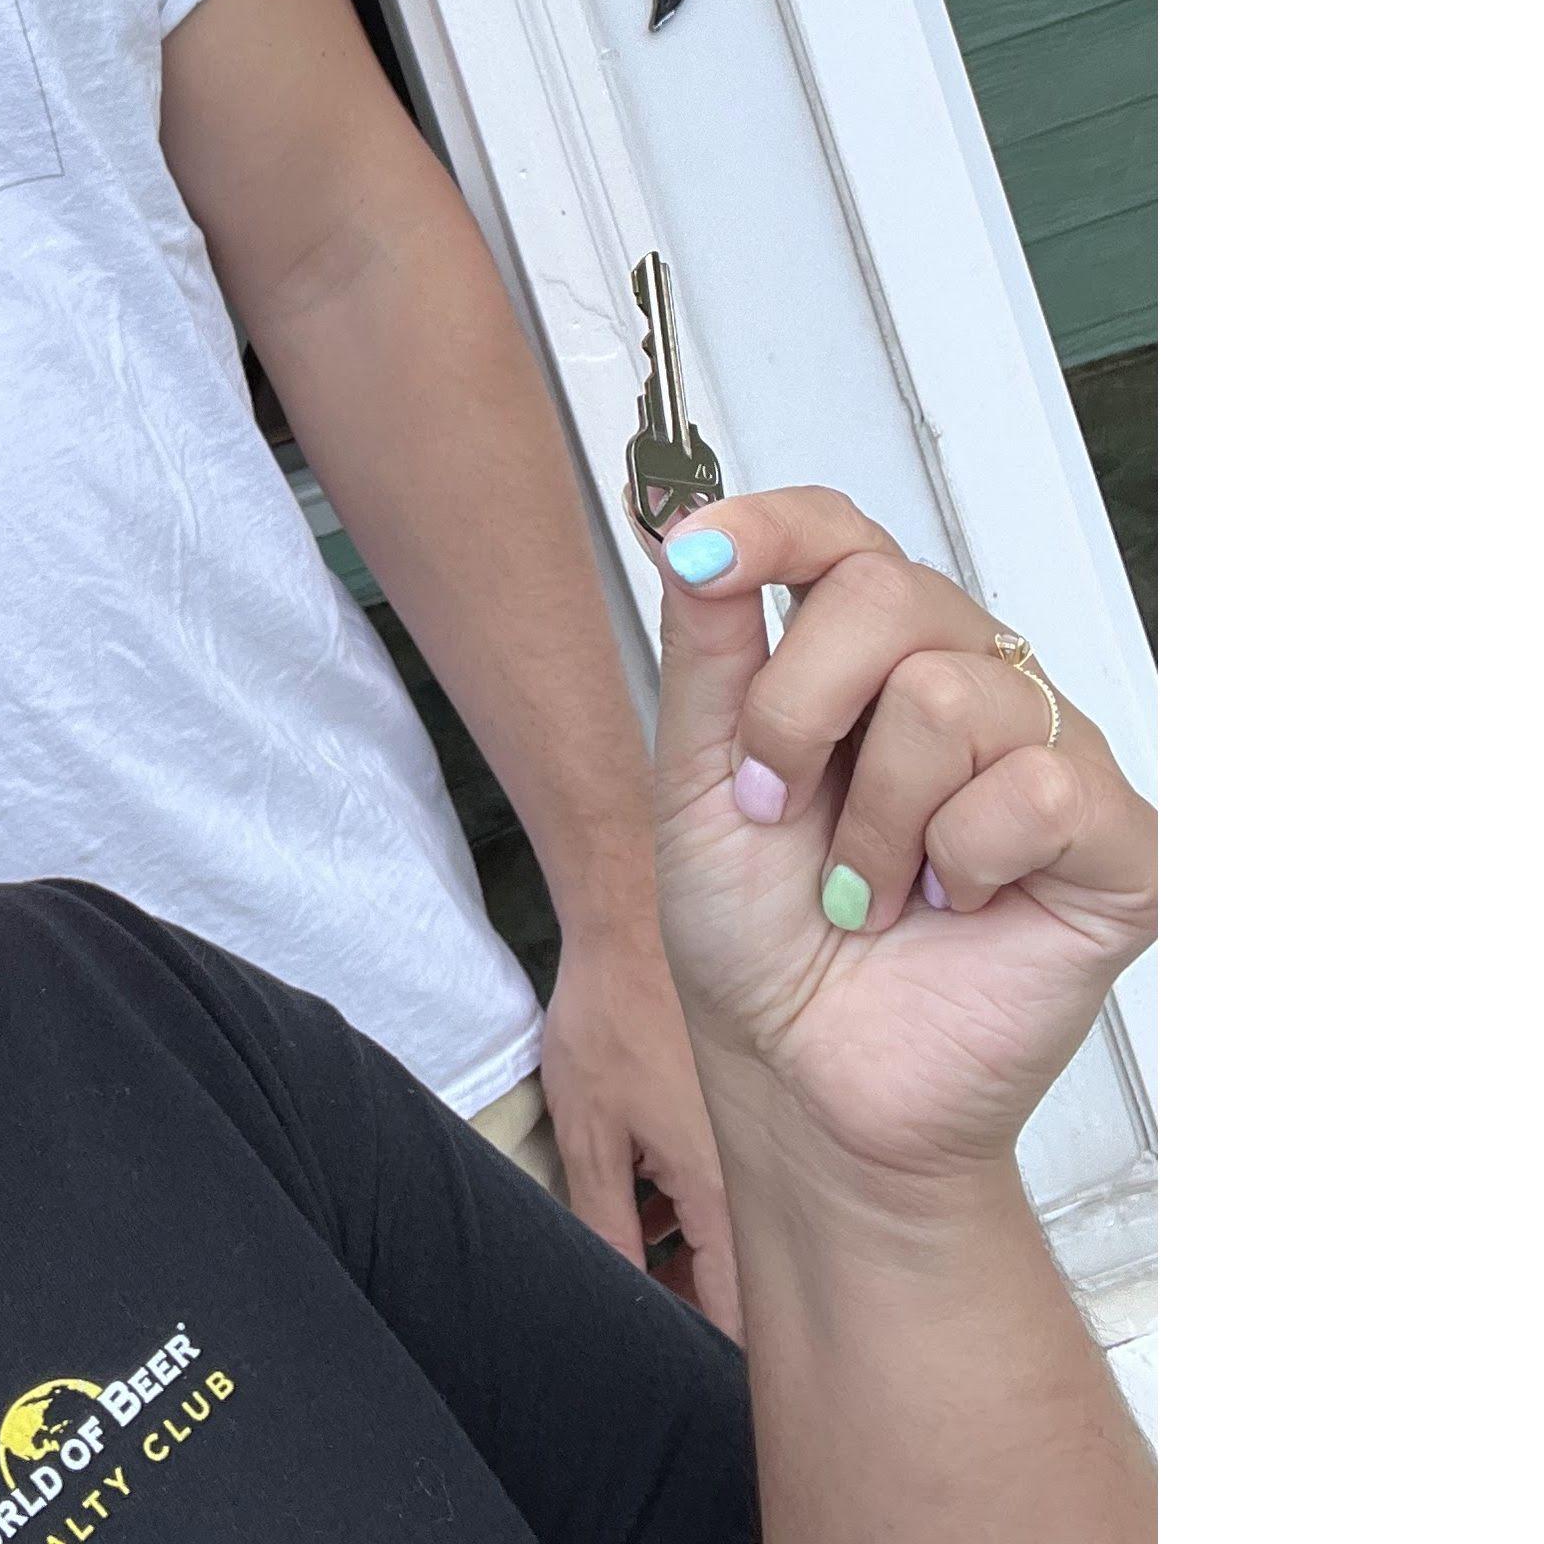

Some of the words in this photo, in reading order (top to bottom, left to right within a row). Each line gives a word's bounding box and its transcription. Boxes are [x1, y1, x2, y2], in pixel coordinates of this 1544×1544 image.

[59, 1415, 106, 1471] OF
[97, 1333, 202, 1427] BEER
[142, 1370, 237, 1463] CLUB
